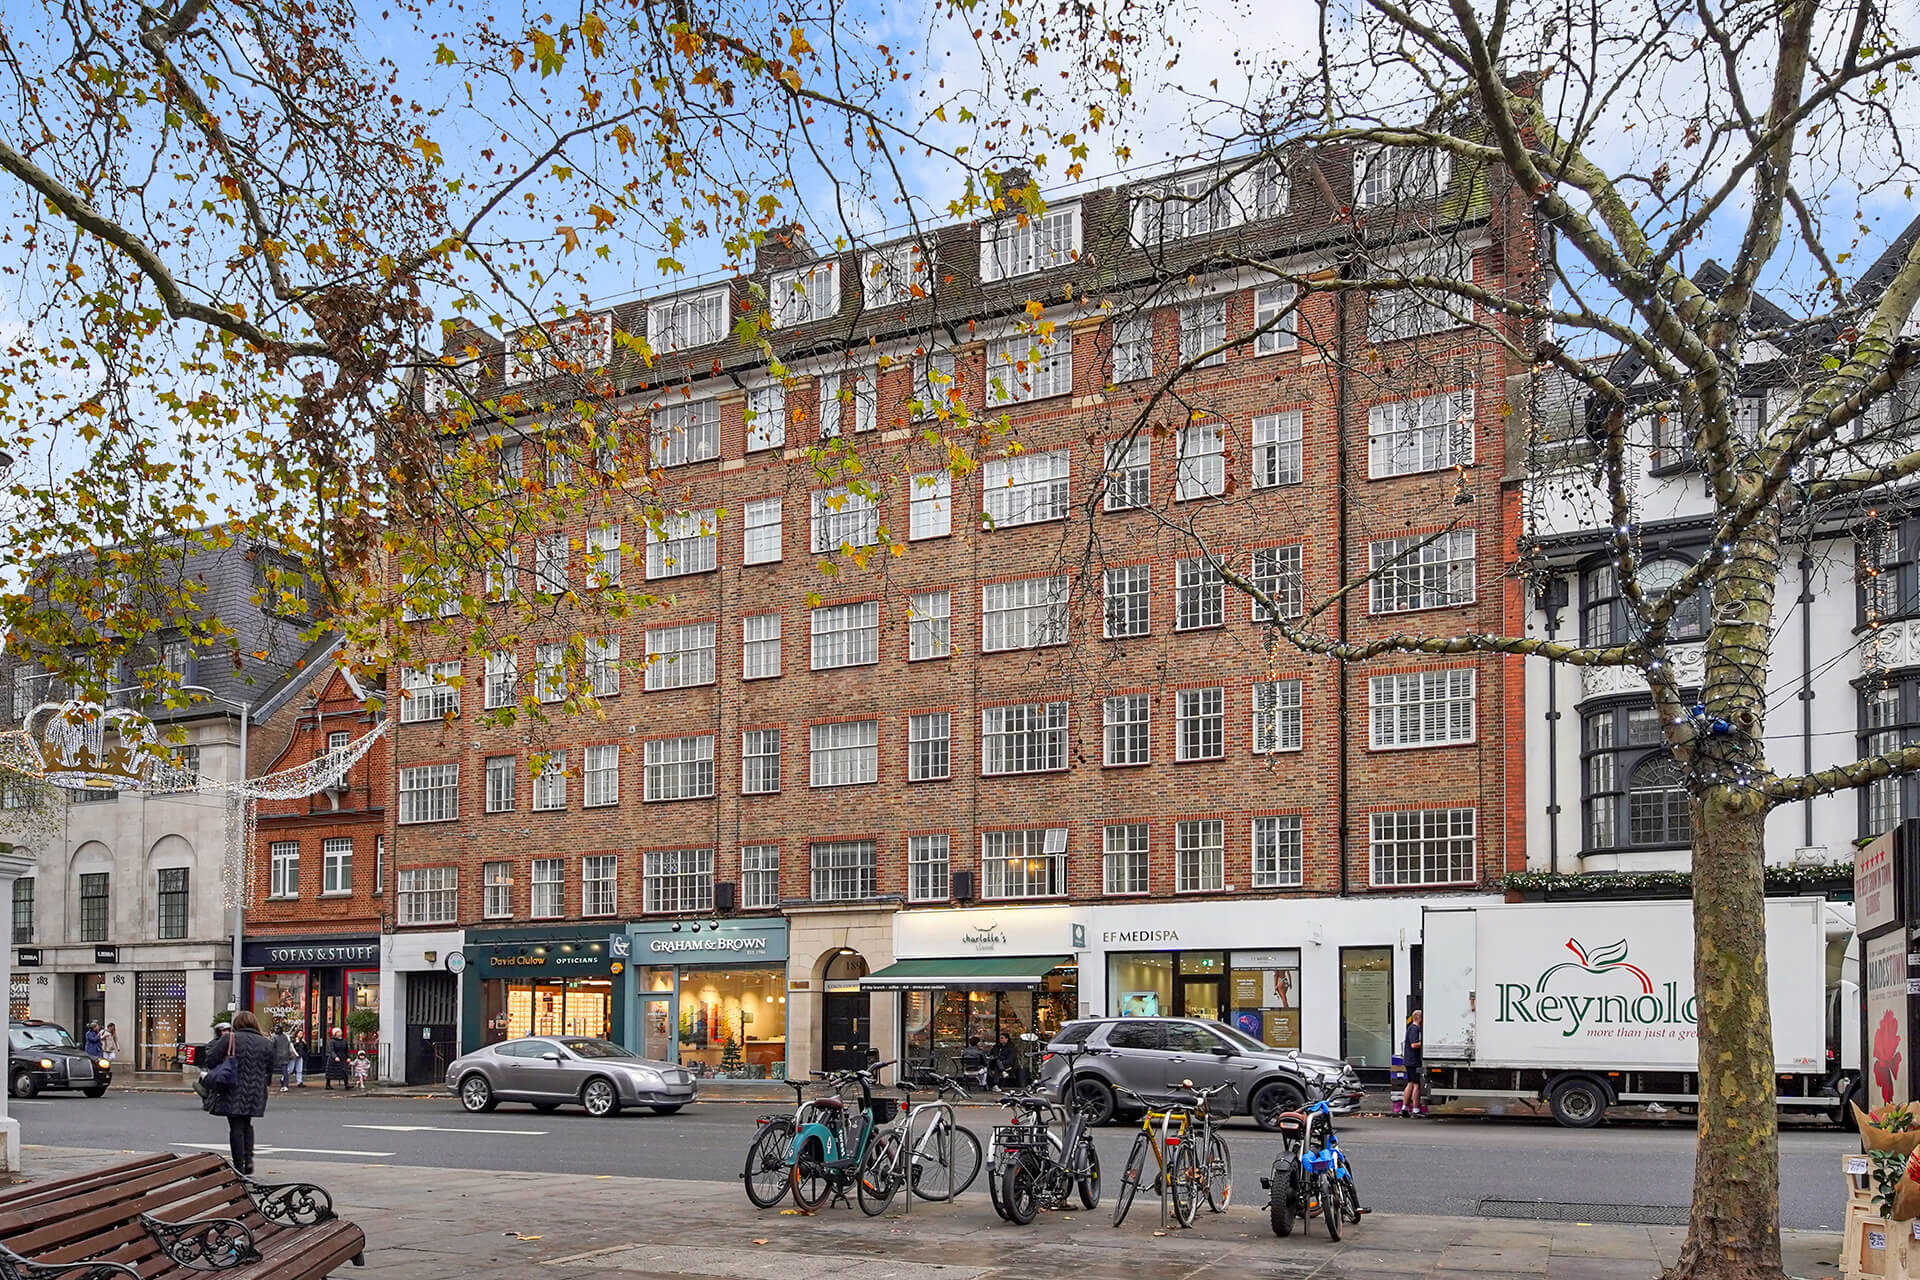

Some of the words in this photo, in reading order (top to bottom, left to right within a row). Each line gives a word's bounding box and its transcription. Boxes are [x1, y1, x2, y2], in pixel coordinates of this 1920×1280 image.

[962, 932, 1007, 944] charlotte's
[1103, 932, 1117, 942] EF
[1119, 930, 1179, 942] MEDISPA
[650, 939, 703, 953] GRAHAM
[704, 939, 716, 950] &
[717, 937, 767, 952] BROWN
[271, 948, 314, 962] SOFAS
[316, 948, 328, 961] &
[328, 946, 374, 961] STUFF
[490, 957, 516, 966] David
[36, 976, 49, 986] 183
[112, 975, 125, 985] 183
[1586, 1029, 1614, 1038] more
[1617, 1027, 1642, 1038] than
[1643, 1027, 1666, 1040] just
[1669, 1030, 1676, 1038] a
